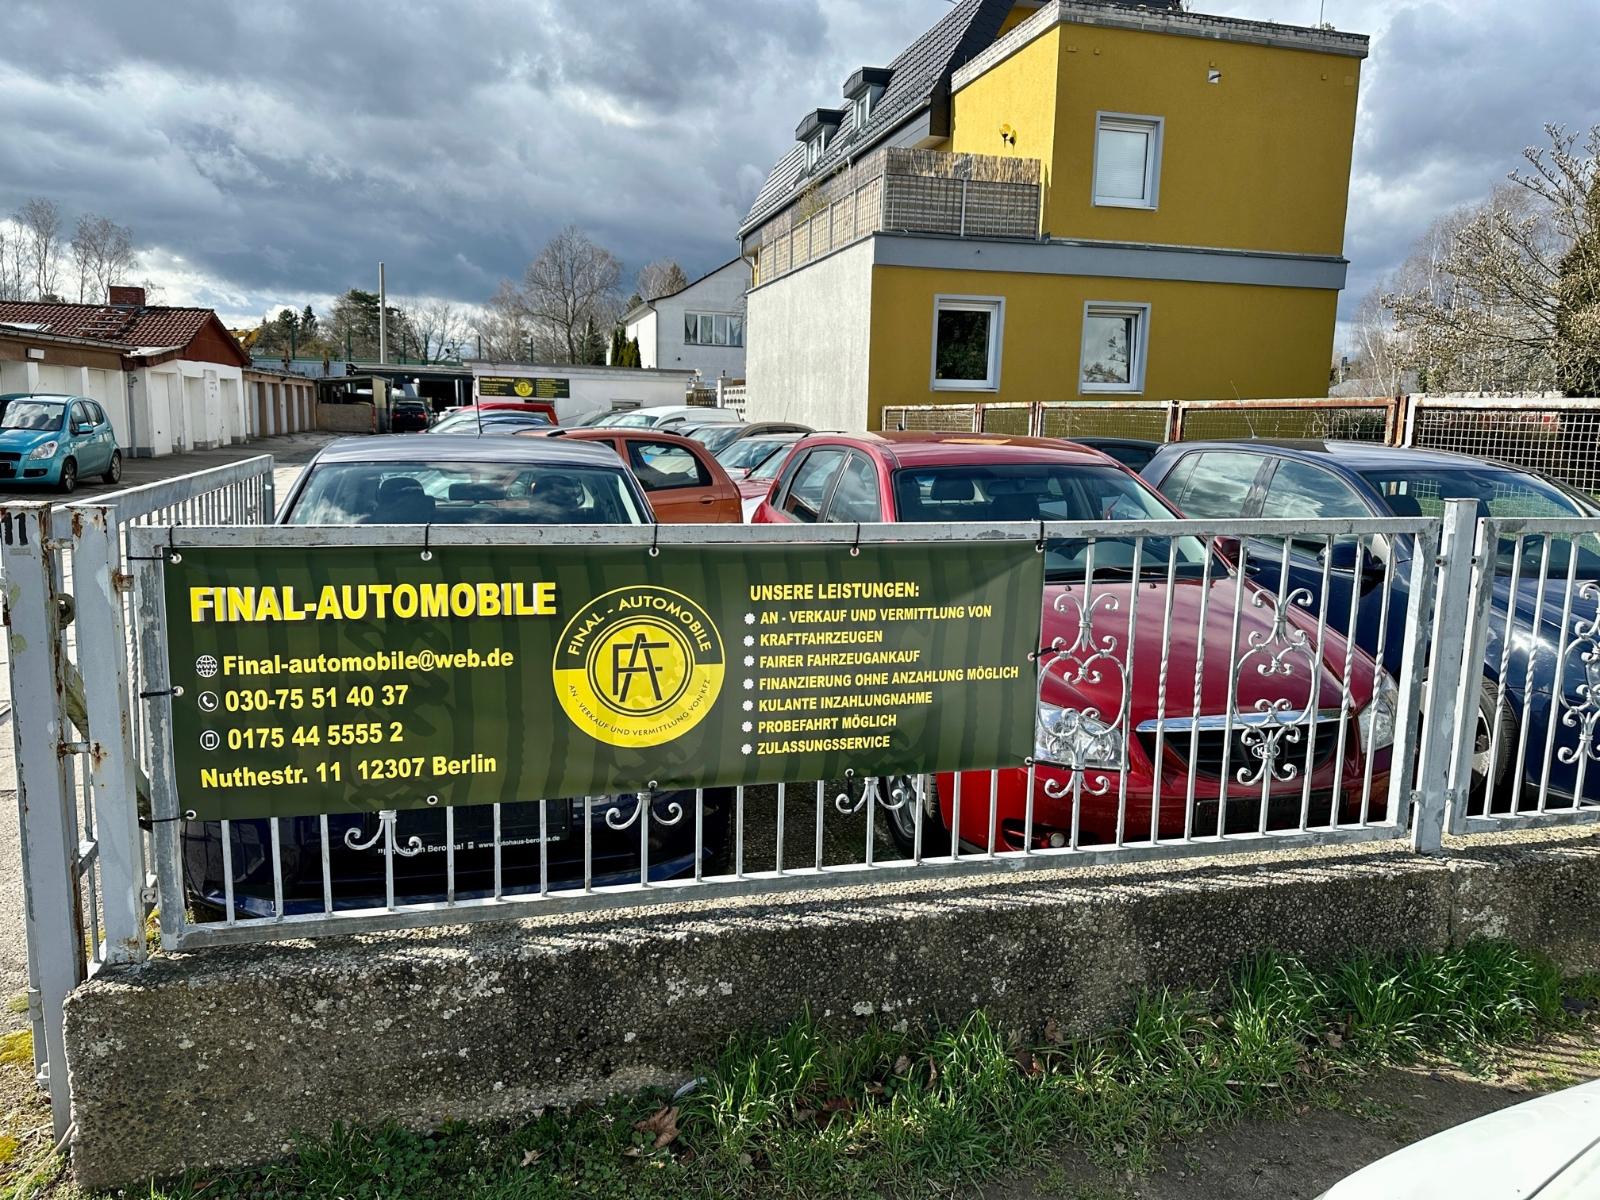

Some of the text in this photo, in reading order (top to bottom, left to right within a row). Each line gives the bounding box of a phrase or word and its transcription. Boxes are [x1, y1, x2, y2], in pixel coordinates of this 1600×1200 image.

[1, 511, 28, 546] 11
[190, 583, 556, 622] FINAL-AUTOMOBILE
[751, 582, 919, 600] UNSERE LEISTUNGEN:
[568, 611, 605, 656] FINAL
[618, 595, 712, 652] AUTOMOBILE
[760, 612, 778, 624] AN
[790, 610, 847, 623] VERKAUF
[851, 609, 876, 621] UND
[880, 606, 964, 620] VERMITTLUNG
[968, 605, 991, 617] VON
[760, 630, 882, 646] KRAFTFAHRZEUGEN
[224, 648, 513, 675] Final-automobile@web.de
[760, 650, 920, 668] FAIRER FAHRZEUGANKAUF
[760, 666, 1018, 690] FINANZIERUNG OHNE ANZAHLUNG MÖGLICH
[226, 685, 408, 711] 030-75 51 40 37
[579, 702, 609, 730] VERKAUF
[610, 725, 630, 736] UND
[632, 710, 690, 737] VERMITTLUNG
[688, 694, 704, 712] VON
[701, 679, 711, 695] KFZ
[759, 692, 932, 712] KULANTE INZAHLUNGNAHME
[228, 722, 403, 749] 0175 44 5555 2
[759, 714, 896, 733] PROBEFAHRT MÖGLICH
[757, 736, 889, 754] ZULASSUNGSSERVICE
[201, 754, 496, 787] Nuthestr. 11 12307 Berlin
